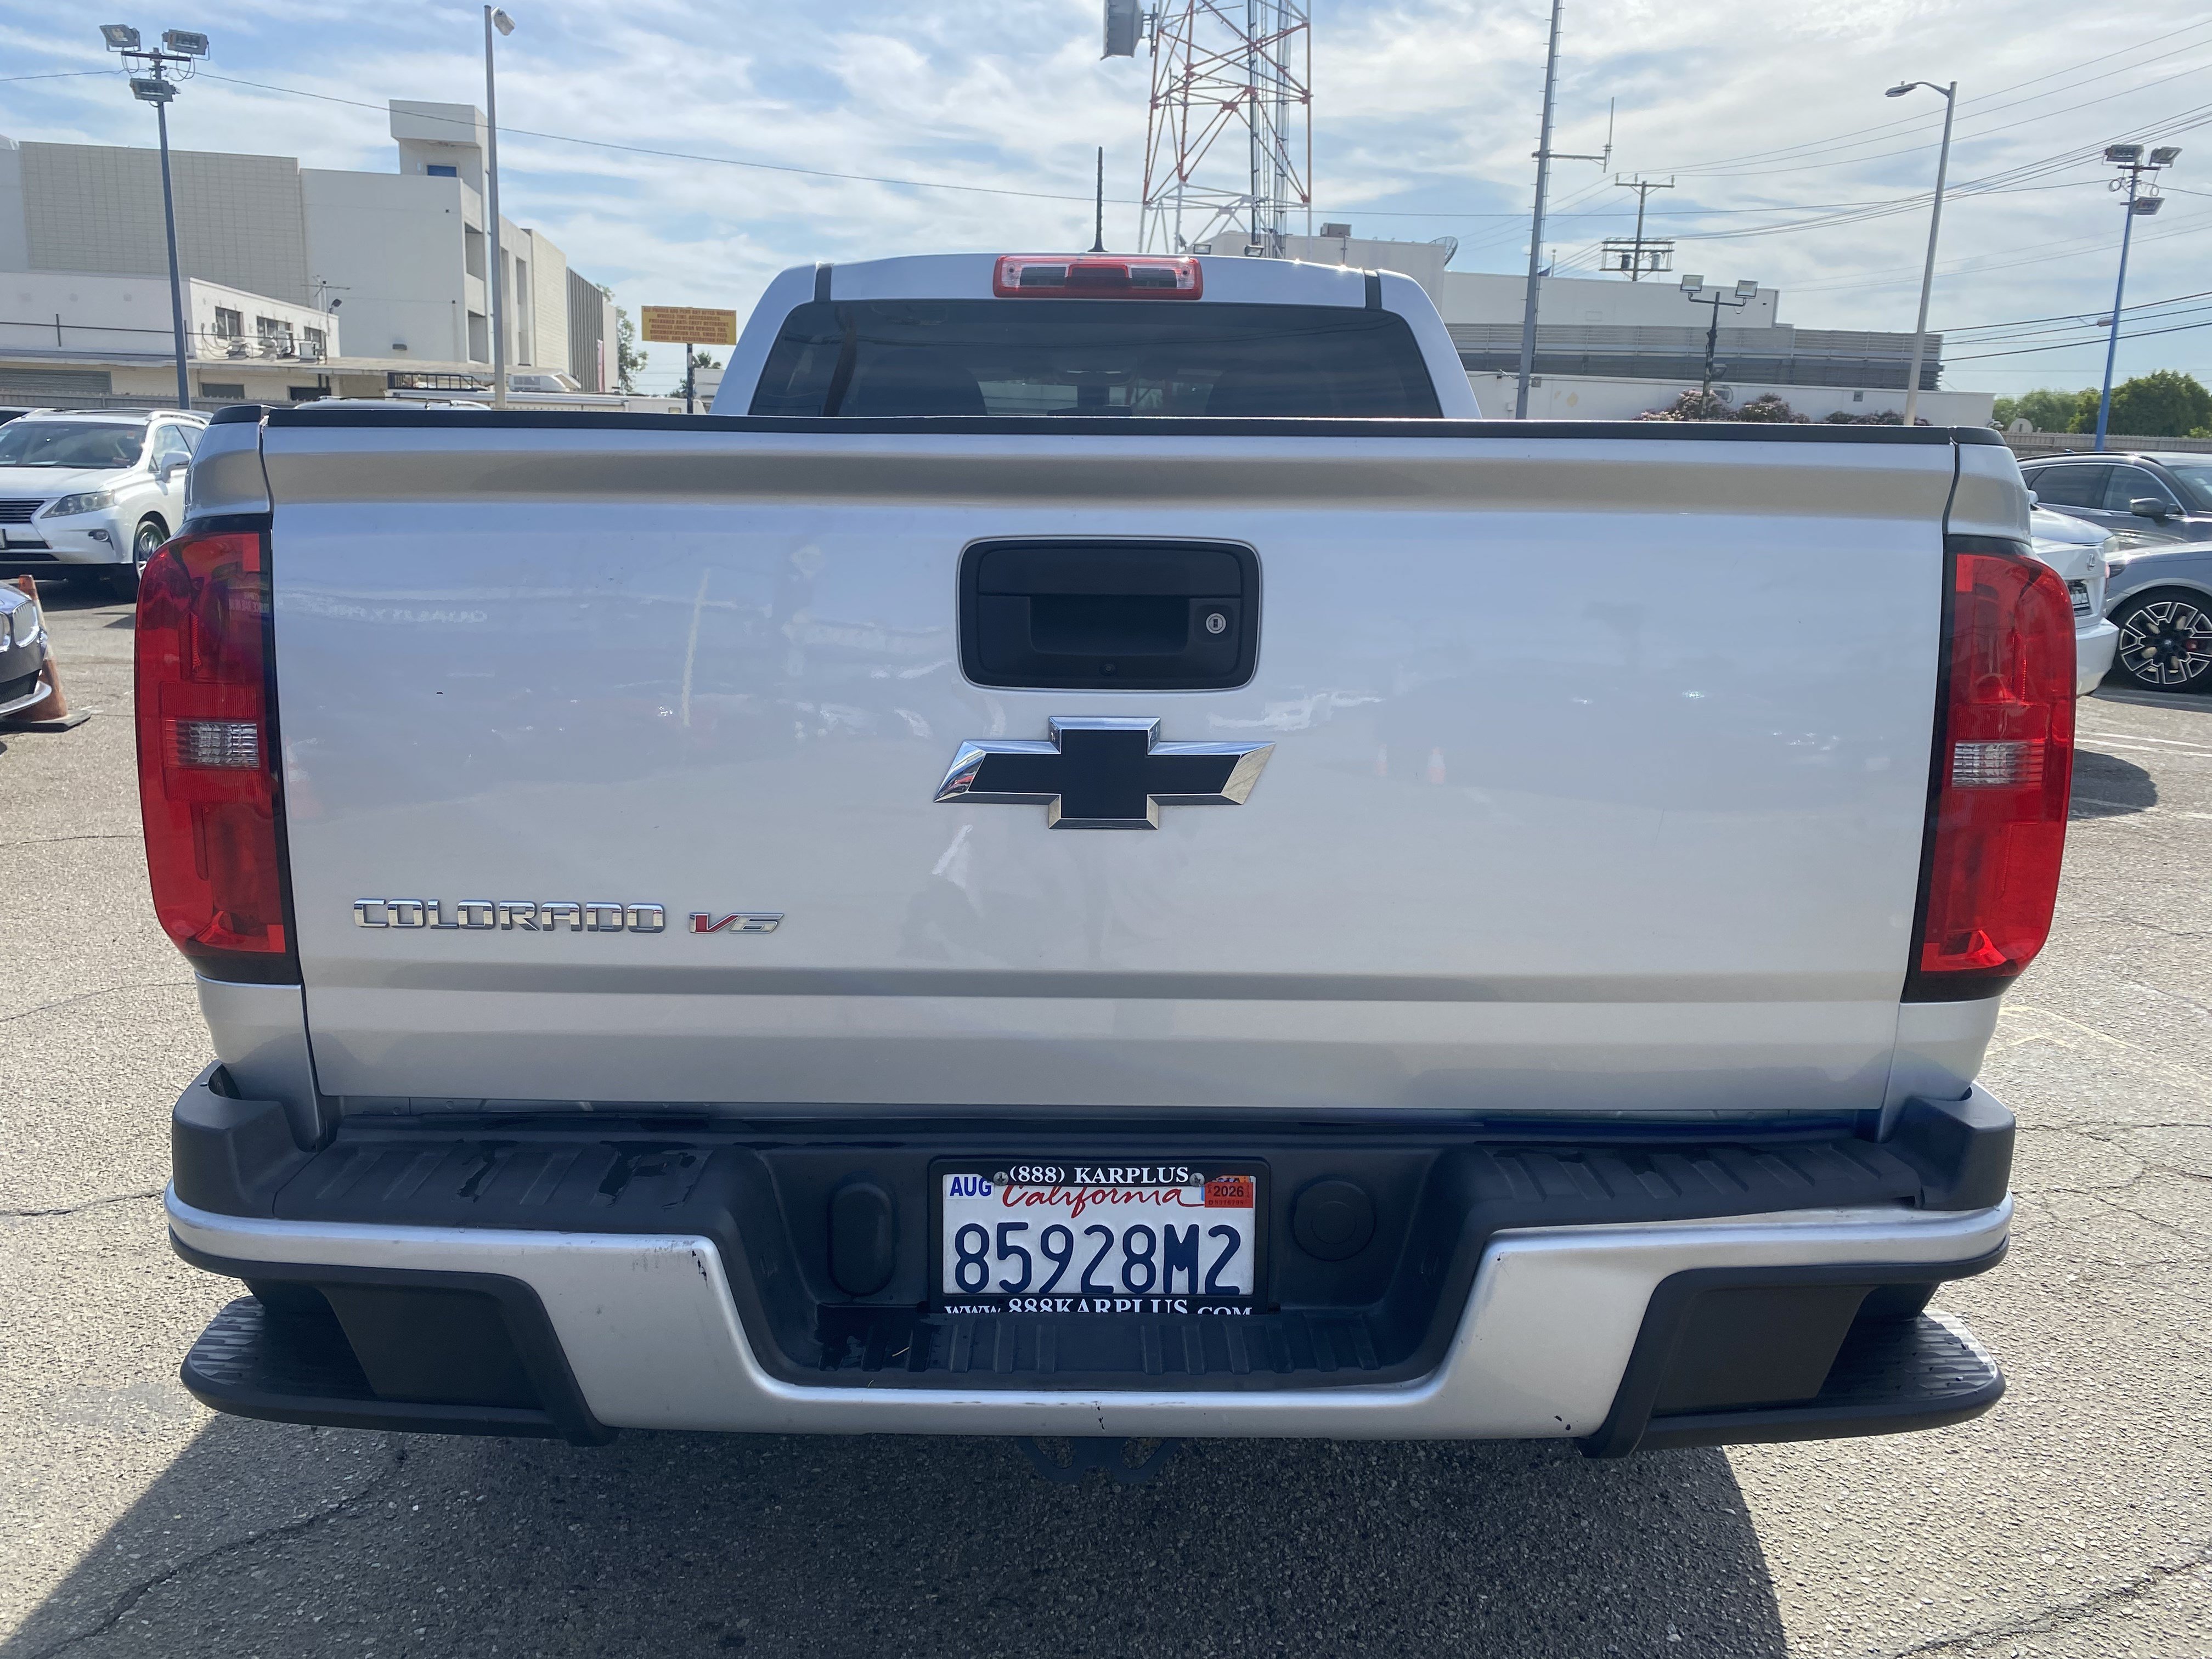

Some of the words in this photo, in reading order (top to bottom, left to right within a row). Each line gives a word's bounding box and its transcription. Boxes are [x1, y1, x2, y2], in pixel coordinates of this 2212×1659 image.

[354, 898, 665, 933] COLORADO
[689, 912, 785, 934] V6
[950, 1176, 992, 1197] AUG
[1009, 1166, 1065, 1183] (888)
[1074, 1166, 1189, 1184] KARPLUS
[1002, 1185, 1205, 1218] California
[1213, 1185, 1244, 1197] 2026
[955, 1222, 1241, 1294] 85928M2
